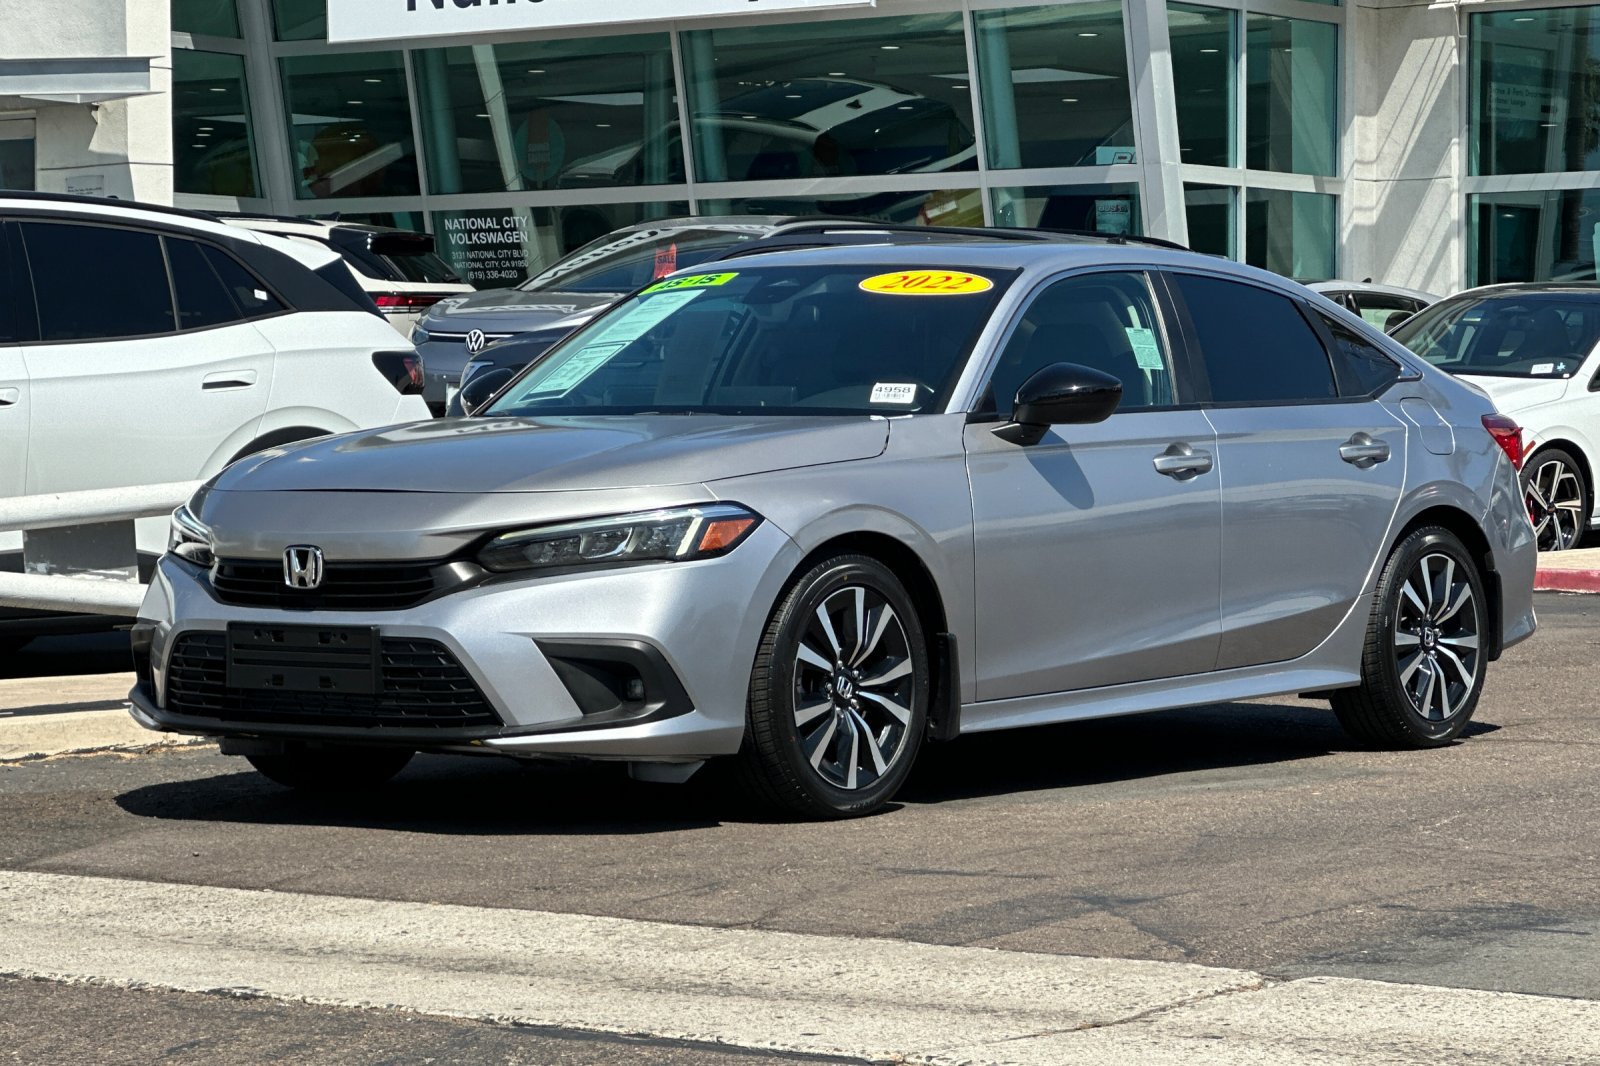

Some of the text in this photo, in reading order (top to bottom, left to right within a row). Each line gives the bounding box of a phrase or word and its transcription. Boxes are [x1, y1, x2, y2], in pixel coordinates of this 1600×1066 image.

[444, 216, 528, 230] NATIONAL CITY
[448, 231, 529, 245] VOLKSWAGEN
[451, 249, 529, 260] 3131 NATIONAL CITY BLVD
[454, 261, 484, 269] NATIONAL
[500, 260, 510, 268] CA
[656, 255, 675, 265] SALE
[467, 270, 485, 280] (619)
[877, 275, 973, 290] 2022
[875, 386, 911, 394] 4958
